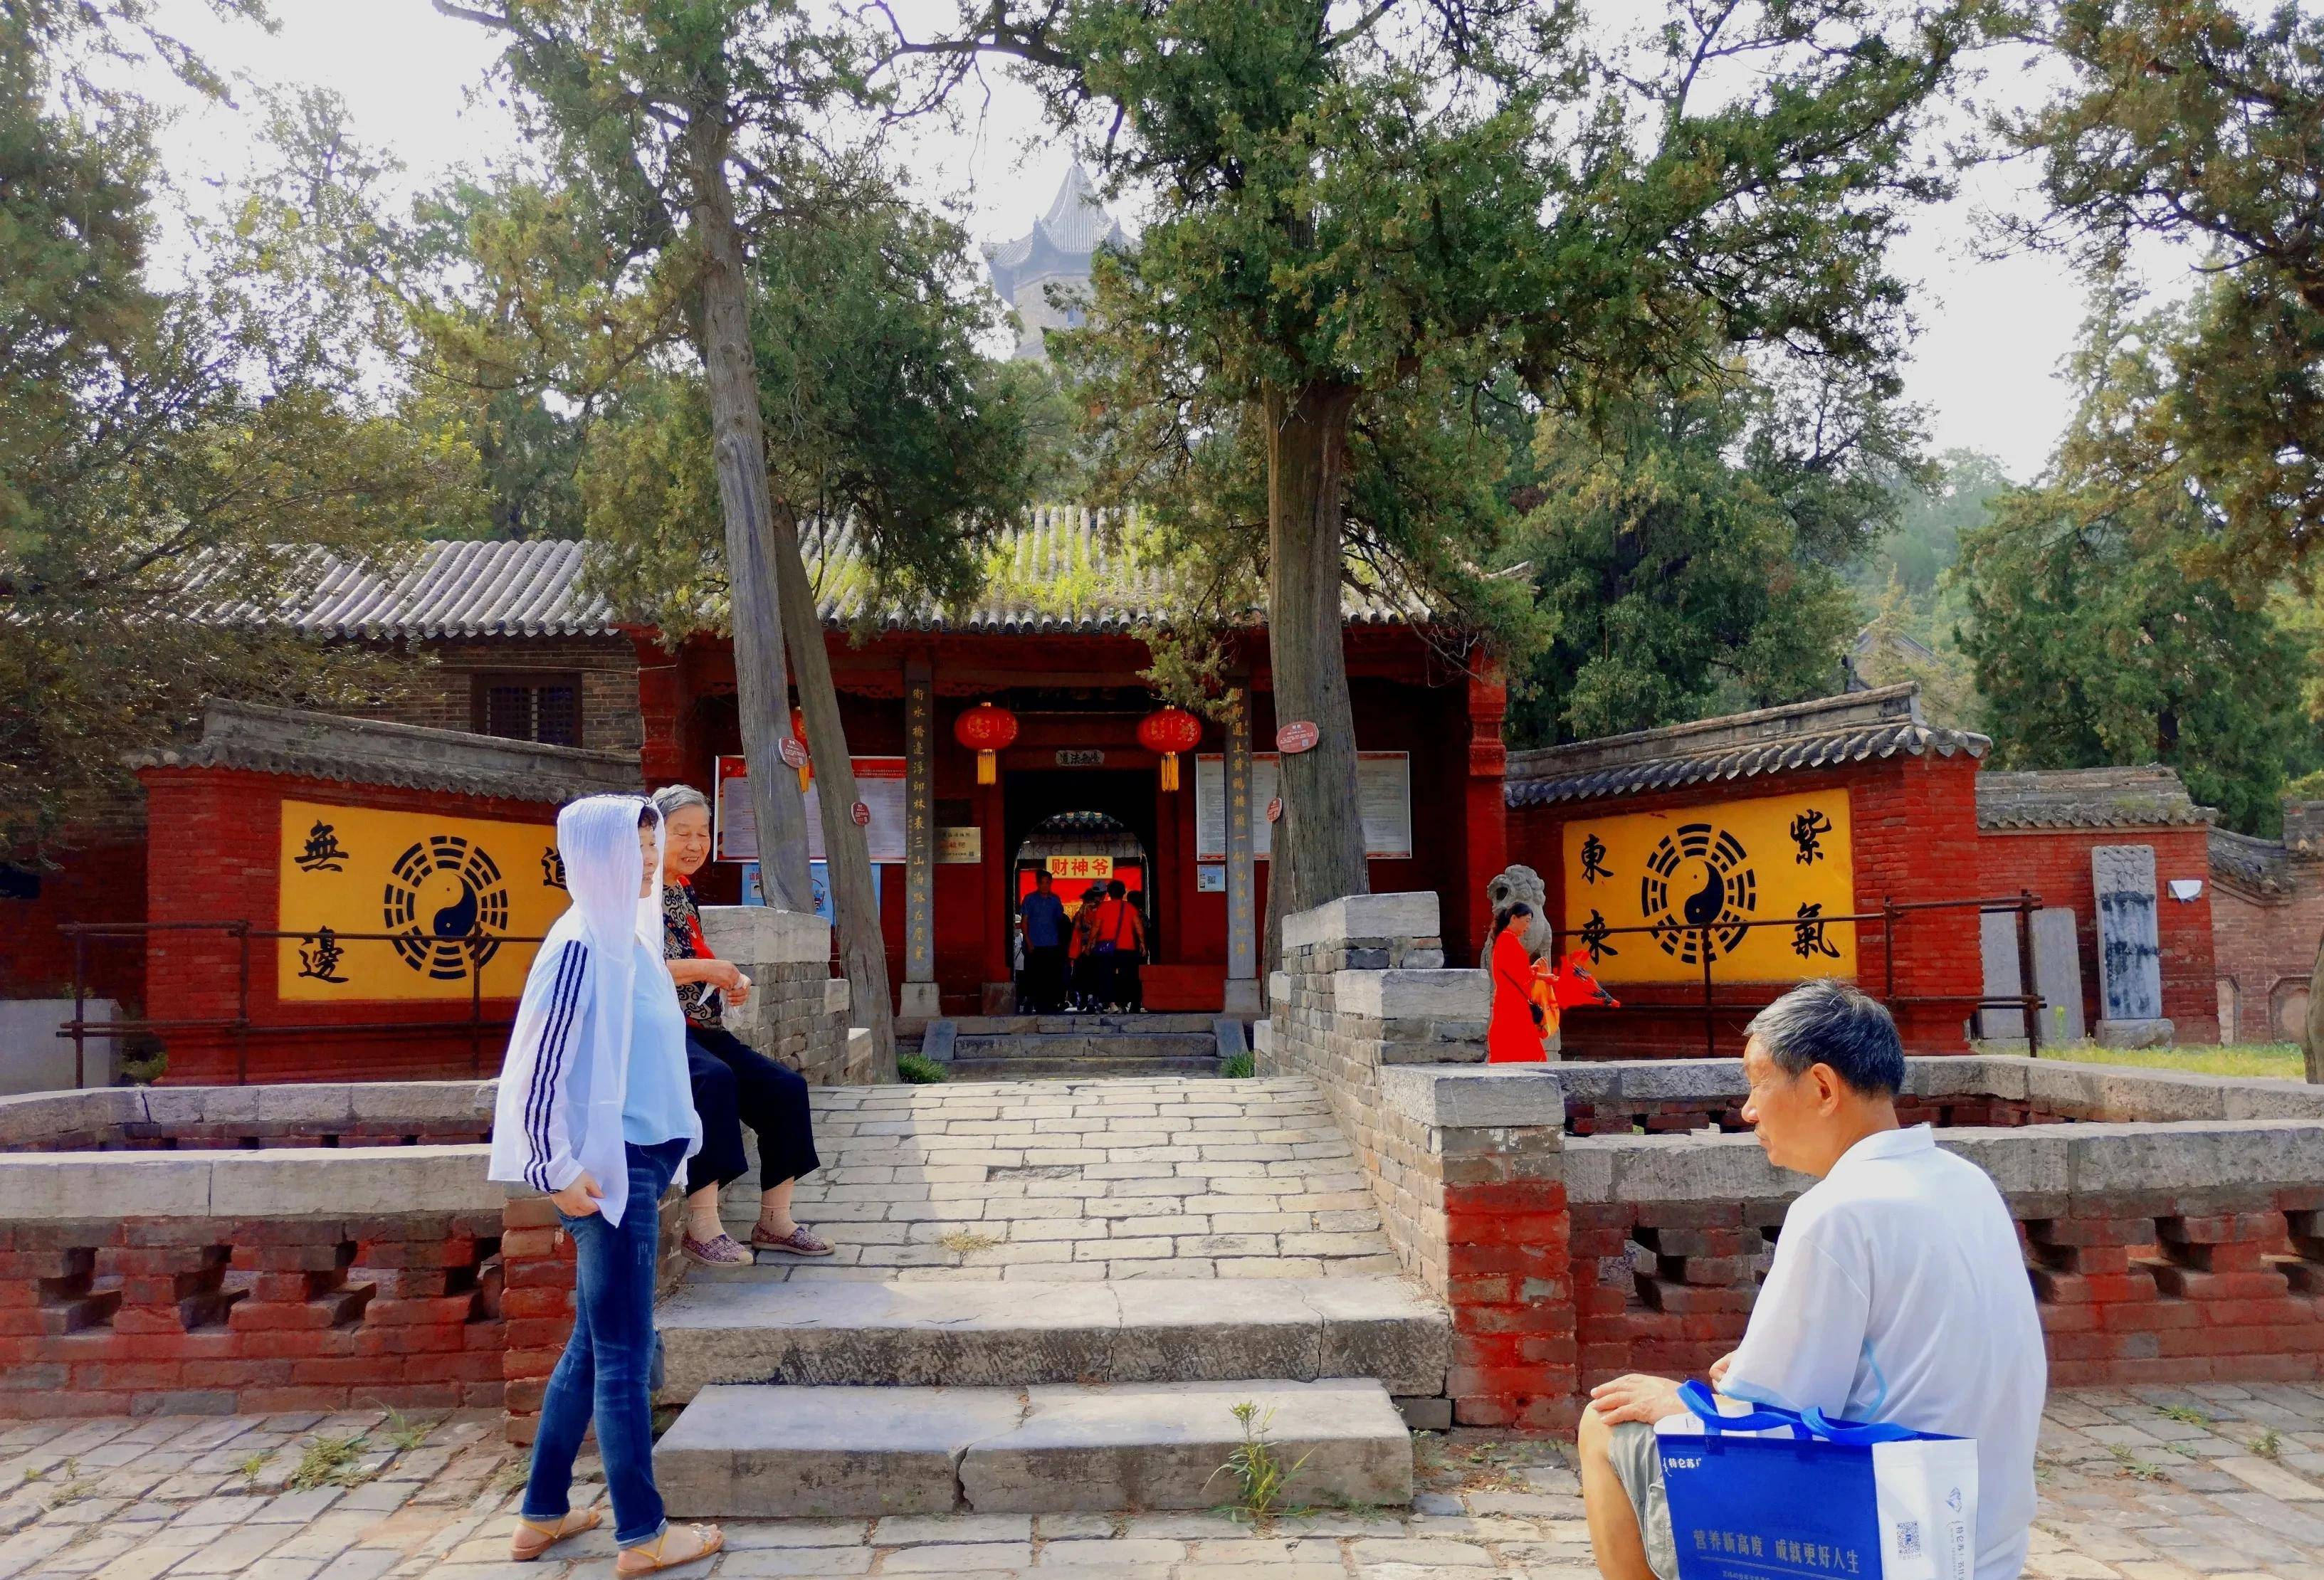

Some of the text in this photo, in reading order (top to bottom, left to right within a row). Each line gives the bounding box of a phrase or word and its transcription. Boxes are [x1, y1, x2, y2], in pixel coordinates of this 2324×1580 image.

[1051, 858, 1108, 876] 财神爷
[1789, 809, 1841, 959] 紫氣
[1693, 1529, 1859, 1574] 营养新高度 成就更好人生
